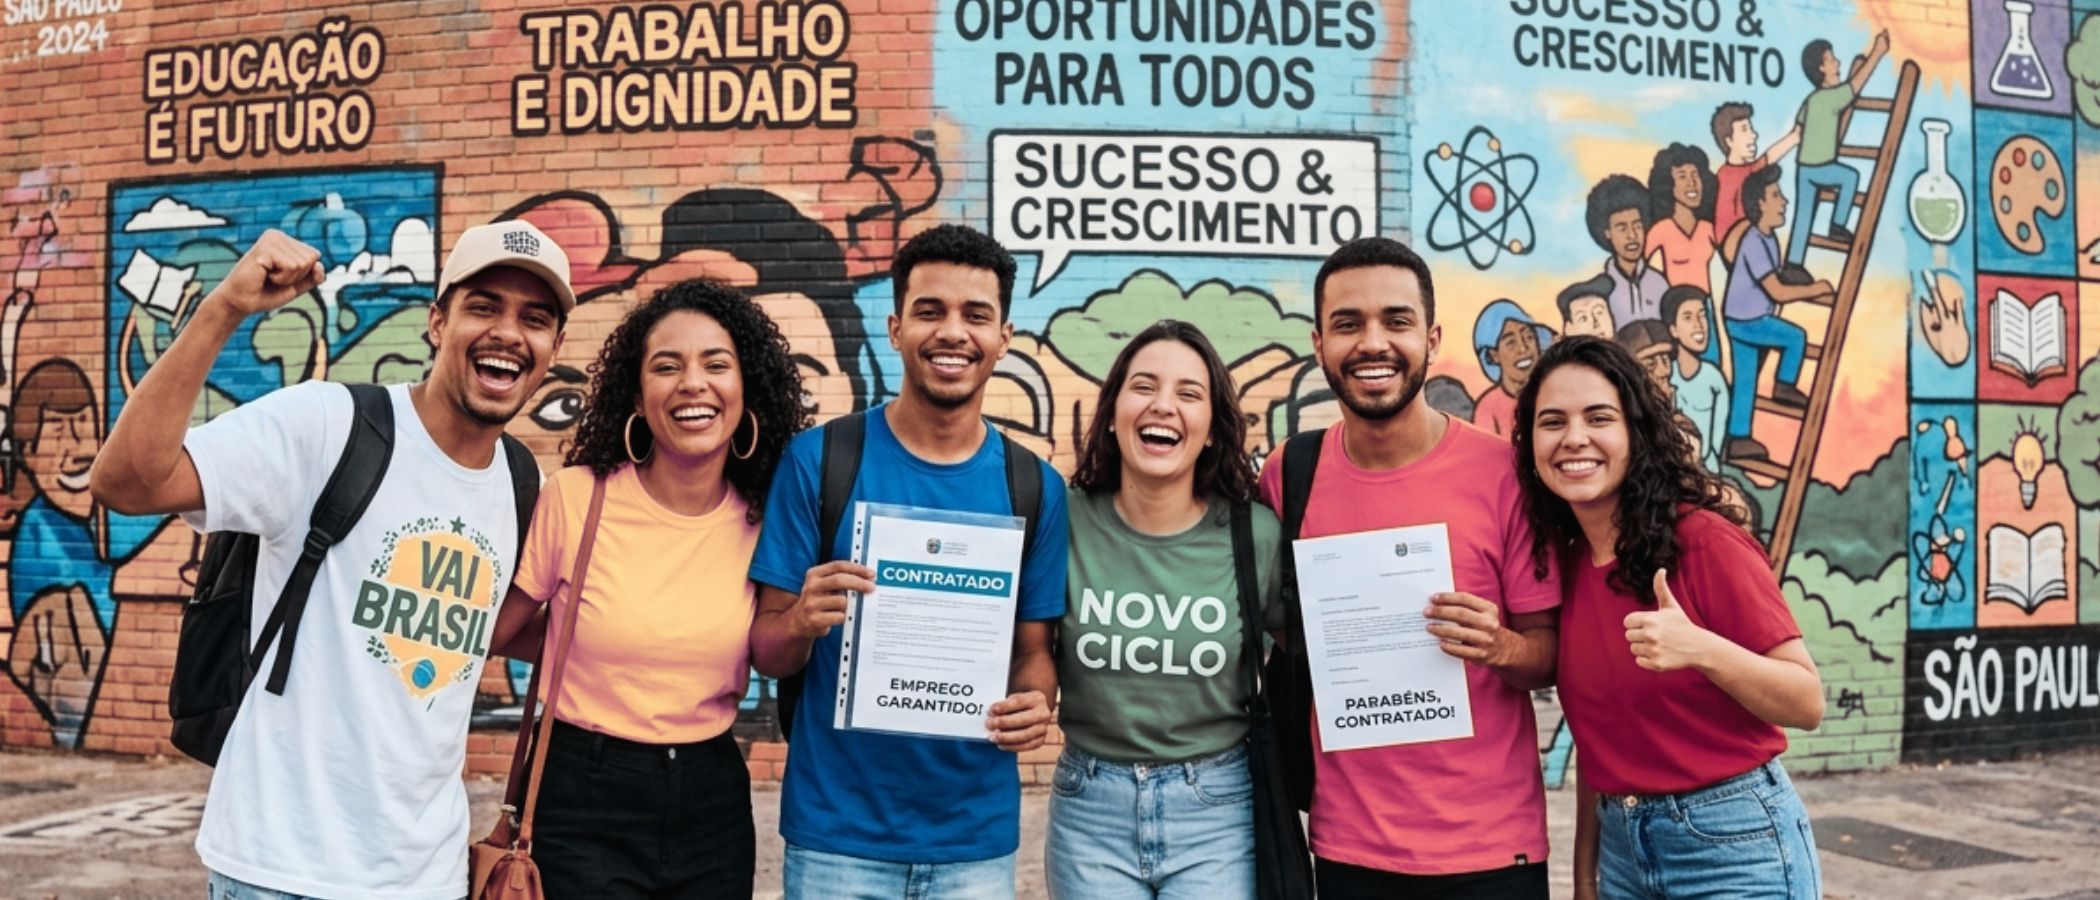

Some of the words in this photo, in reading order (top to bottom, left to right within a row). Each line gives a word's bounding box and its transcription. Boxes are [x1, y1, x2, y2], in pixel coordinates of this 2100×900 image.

[37, 19, 109, 56] 2024
[526, 3, 845, 66] TRABALHO
[954, 0, 1376, 50] OPORTUNIDADES
[1735, 0, 1765, 38] &
[147, 20, 381, 98] EDUCAÇÃO
[995, 52, 1125, 106] PARA
[1139, 54, 1315, 110] TODOS
[1513, 24, 1785, 88] CRESCIMENTO
[516, 78, 546, 130] E
[565, 67, 851, 129] DIGNIDADE
[148, 100, 174, 159] É
[190, 94, 371, 157] FUTURO
[1015, 142, 1280, 193] SUCESSO
[1296, 149, 1335, 195] &
[1010, 196, 1362, 245] CRESCIMENTO
[421, 540, 480, 600] VAI
[882, 567, 1006, 590] CONTRATADO
[352, 579, 489, 657] BRASIL
[1079, 588, 1227, 633] NOVO
[1076, 632, 1227, 678] CICLO
[1924, 634, 2004, 721] SÃO
[2015, 645, 2100, 713] PAUL
[890, 677, 974, 697] EMPREGO
[1345, 689, 1442, 711] PARABÉNS,
[1334, 705, 1456, 729] CONTRATADO!
